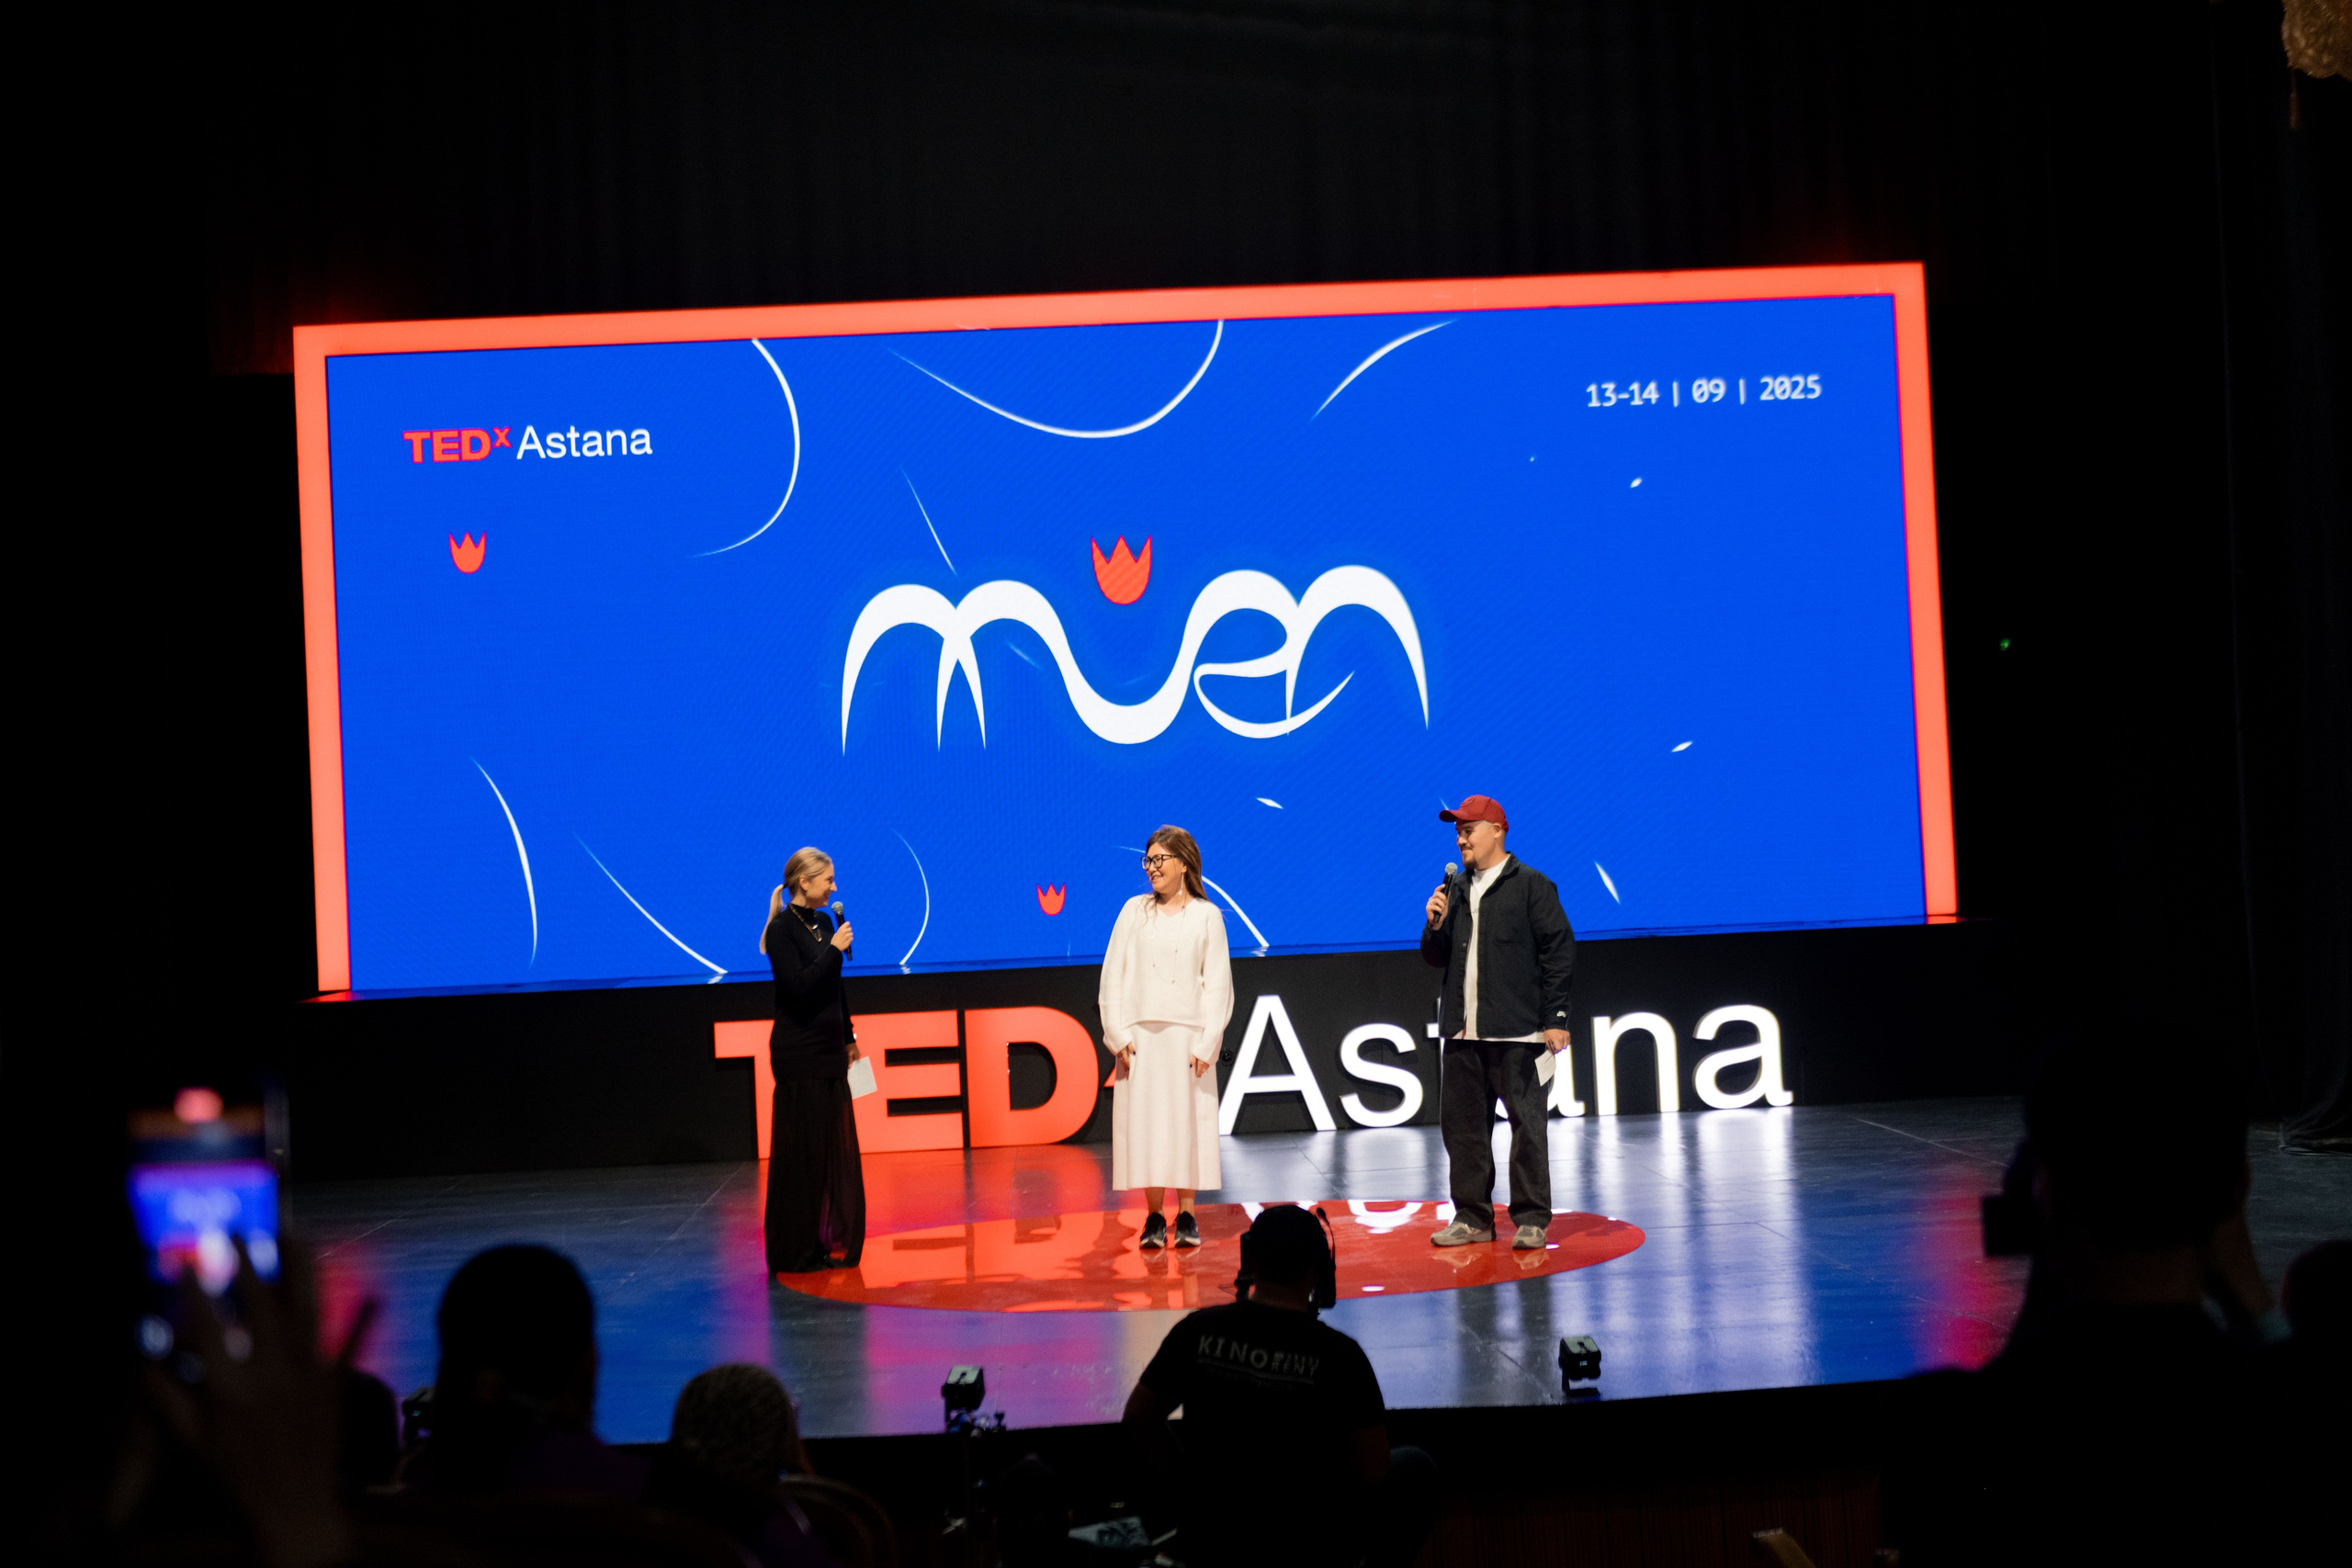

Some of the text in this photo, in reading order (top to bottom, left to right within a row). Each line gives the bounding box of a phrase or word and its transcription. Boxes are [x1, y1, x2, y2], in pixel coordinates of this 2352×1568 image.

[1586, 380, 1659, 407] 13-14
[1691, 378, 1726, 403] 09
[1759, 374, 1822, 400] 2025
[516, 425, 653, 460] Astana
[714, 994, 1793, 1160] ED Asna
